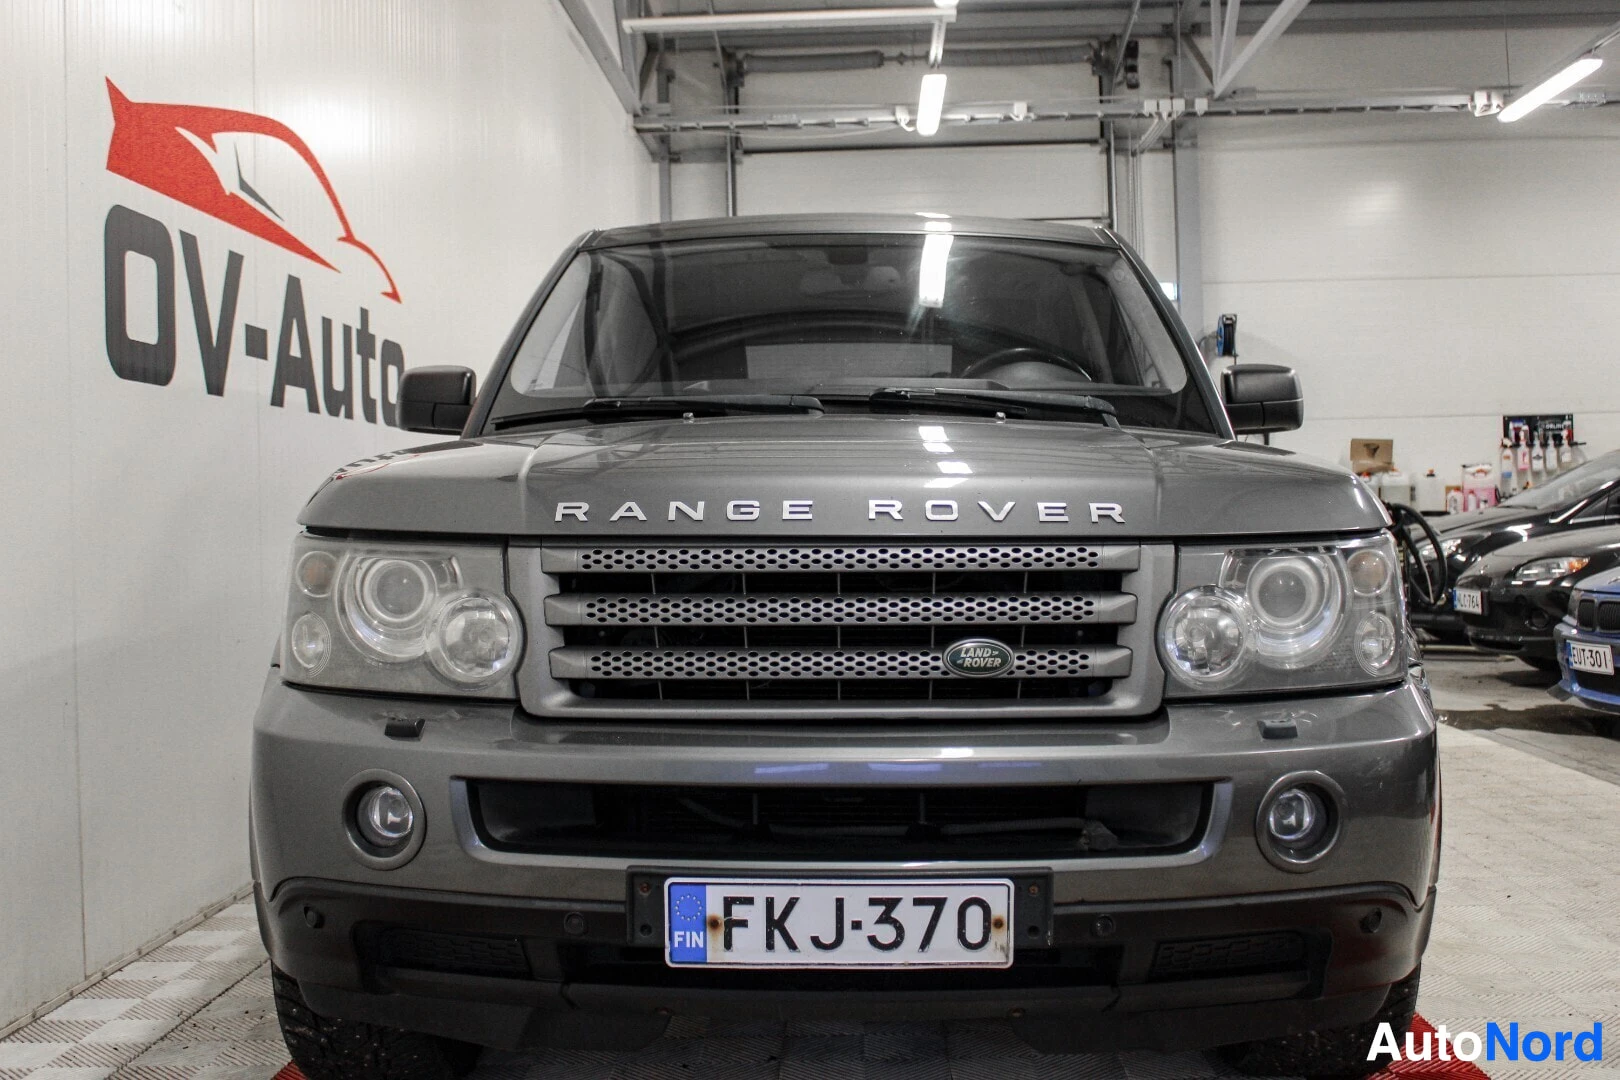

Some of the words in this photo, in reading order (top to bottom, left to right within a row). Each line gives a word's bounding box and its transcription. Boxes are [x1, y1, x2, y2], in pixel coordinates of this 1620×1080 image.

[104, 204, 406, 427] OV-Auto
[555, 501, 813, 522] RANGE
[867, 499, 1126, 523] ROVER
[960, 647, 991, 658] LAND
[964, 658, 1001, 668] ROVER
[1572, 647, 1608, 669] EUT-301
[723, 896, 992, 953] FKJ-370
[673, 930, 704, 949] FIN
